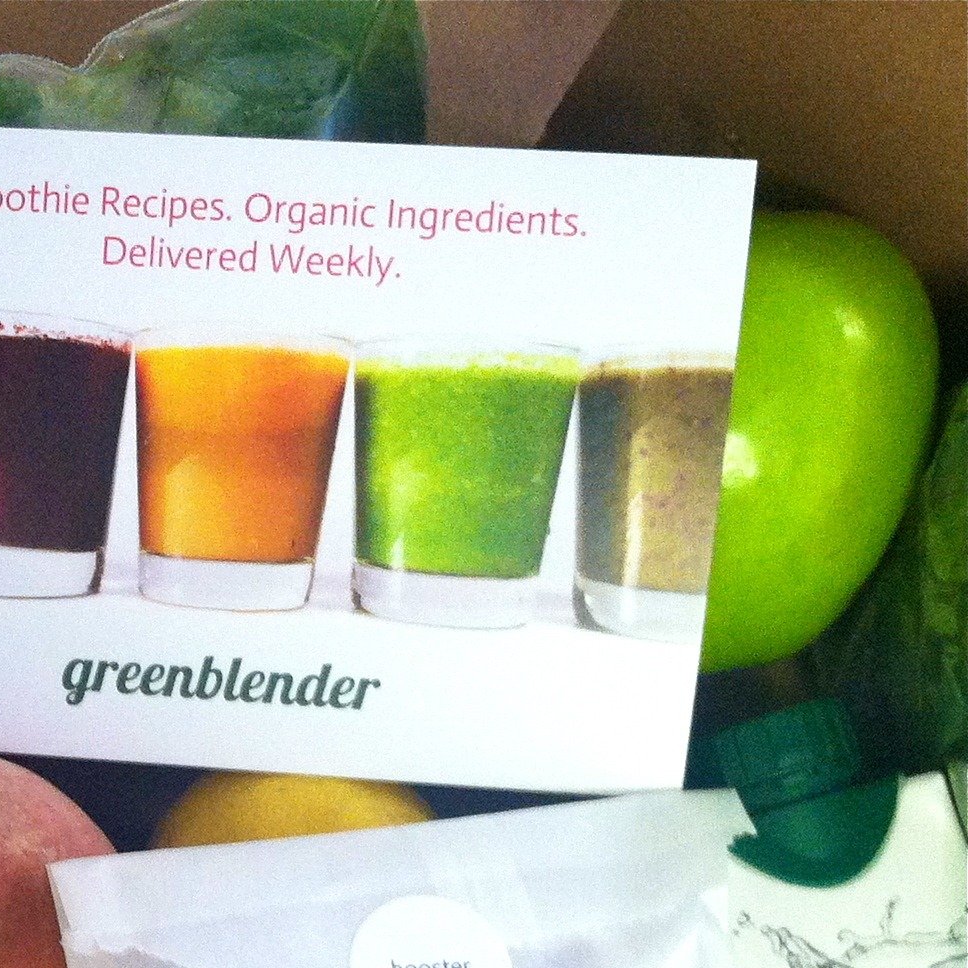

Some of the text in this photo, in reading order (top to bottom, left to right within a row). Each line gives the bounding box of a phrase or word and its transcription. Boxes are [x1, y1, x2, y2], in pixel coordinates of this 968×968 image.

[101, 185, 233, 227] Recipes.
[245, 192, 376, 235] Organic
[387, 198, 588, 239] Ingredients.
[102, 235, 402, 286] Delivered Weekly.
[61, 655, 381, 710] greenblender
